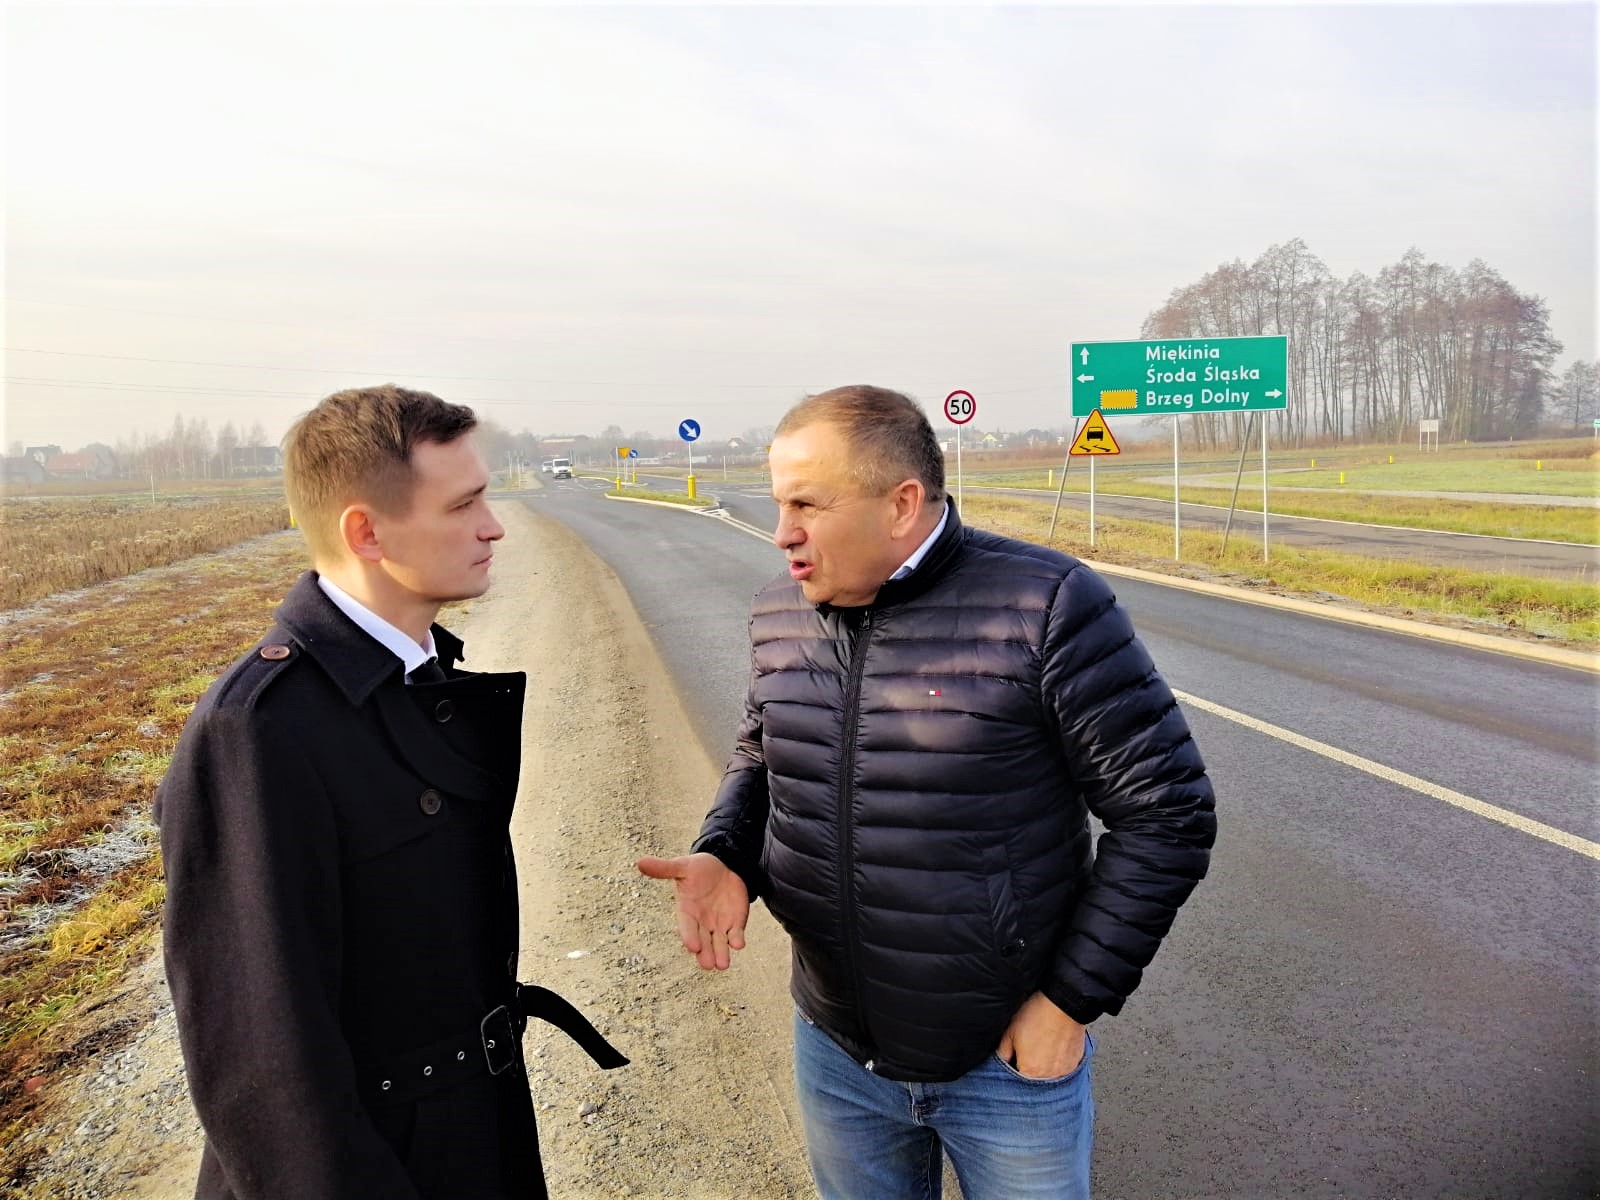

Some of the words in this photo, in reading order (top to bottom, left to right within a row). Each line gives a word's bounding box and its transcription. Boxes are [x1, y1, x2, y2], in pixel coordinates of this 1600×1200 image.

[1145, 344, 1220, 364] Miękinia
[1145, 364, 1197, 383] Środa
[1203, 362, 1260, 384] Śląska
[950, 398, 972, 416] 50
[1145, 391, 1194, 408] Brzeg
[1201, 389, 1250, 406] Dolny
